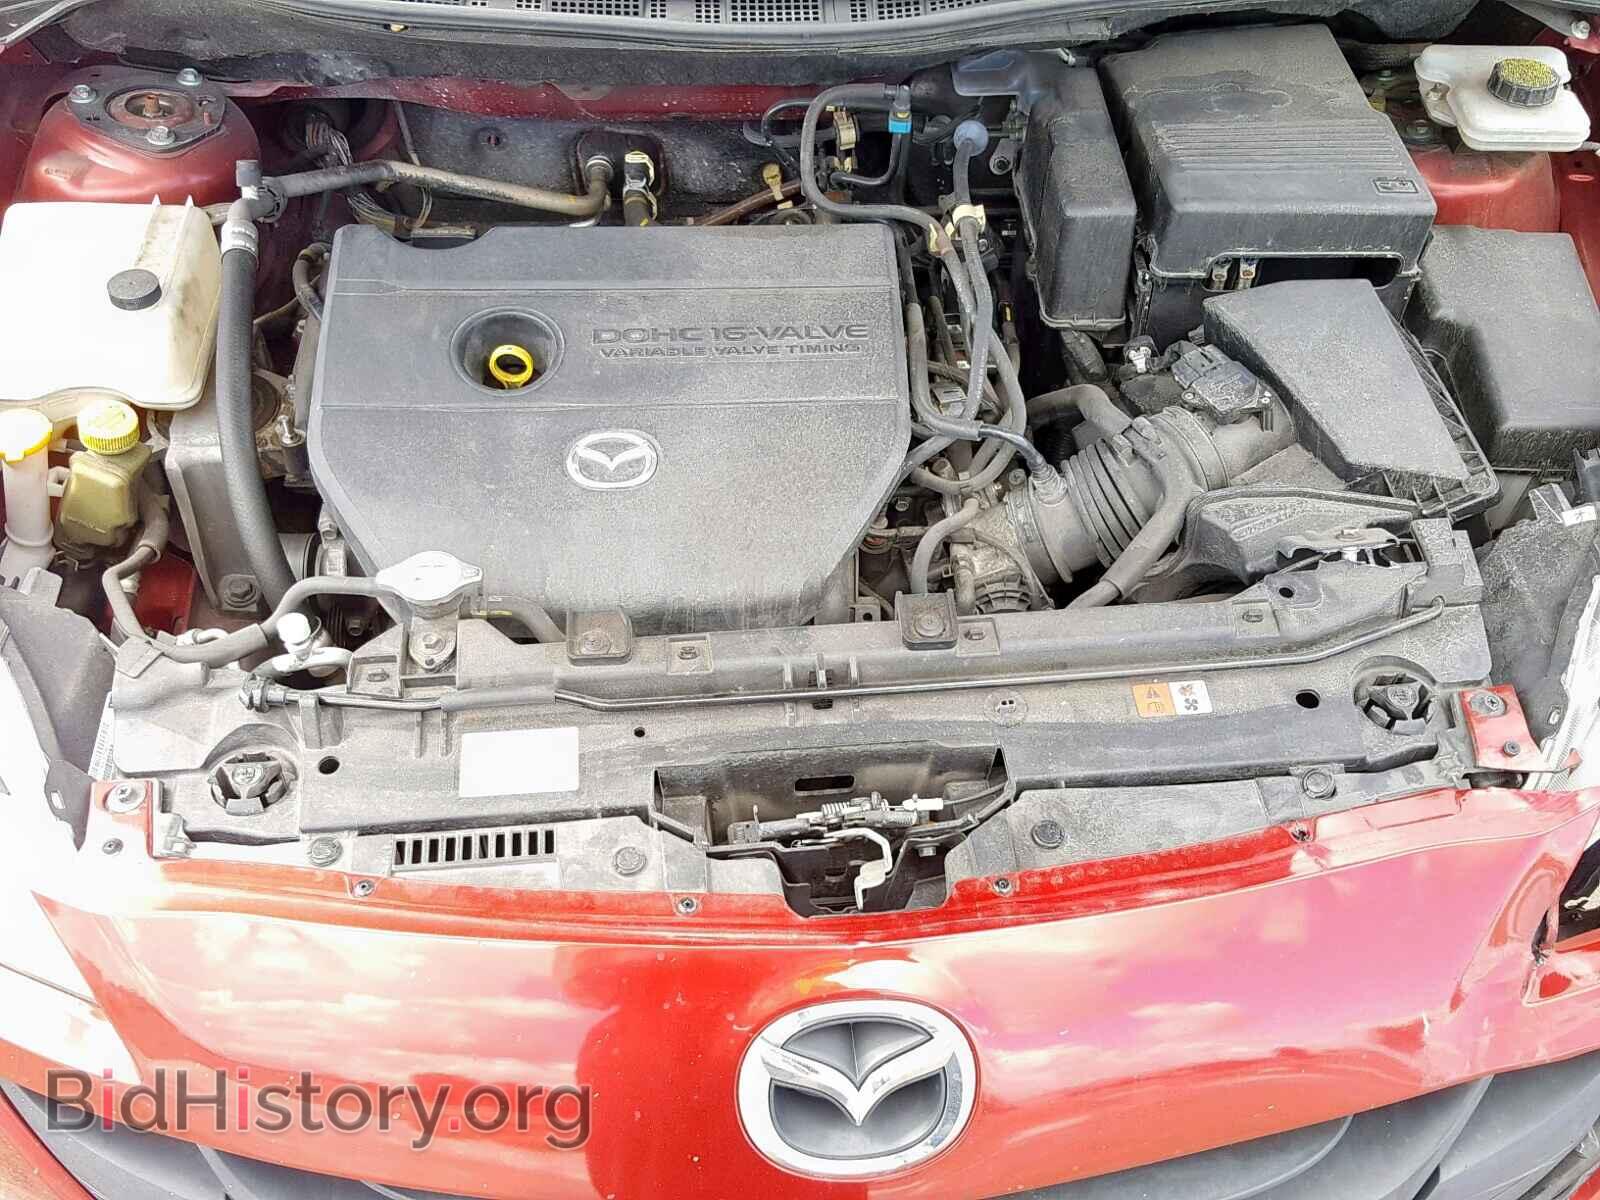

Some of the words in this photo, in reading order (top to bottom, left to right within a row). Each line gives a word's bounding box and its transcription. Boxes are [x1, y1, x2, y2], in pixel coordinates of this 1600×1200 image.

[593, 328, 704, 344] DOHC
[711, 324, 869, 341] 16-VALVE
[600, 346, 706, 358] VARIABLE
[712, 345, 780, 356] VALVE
[786, 342, 860, 354] TIMING
